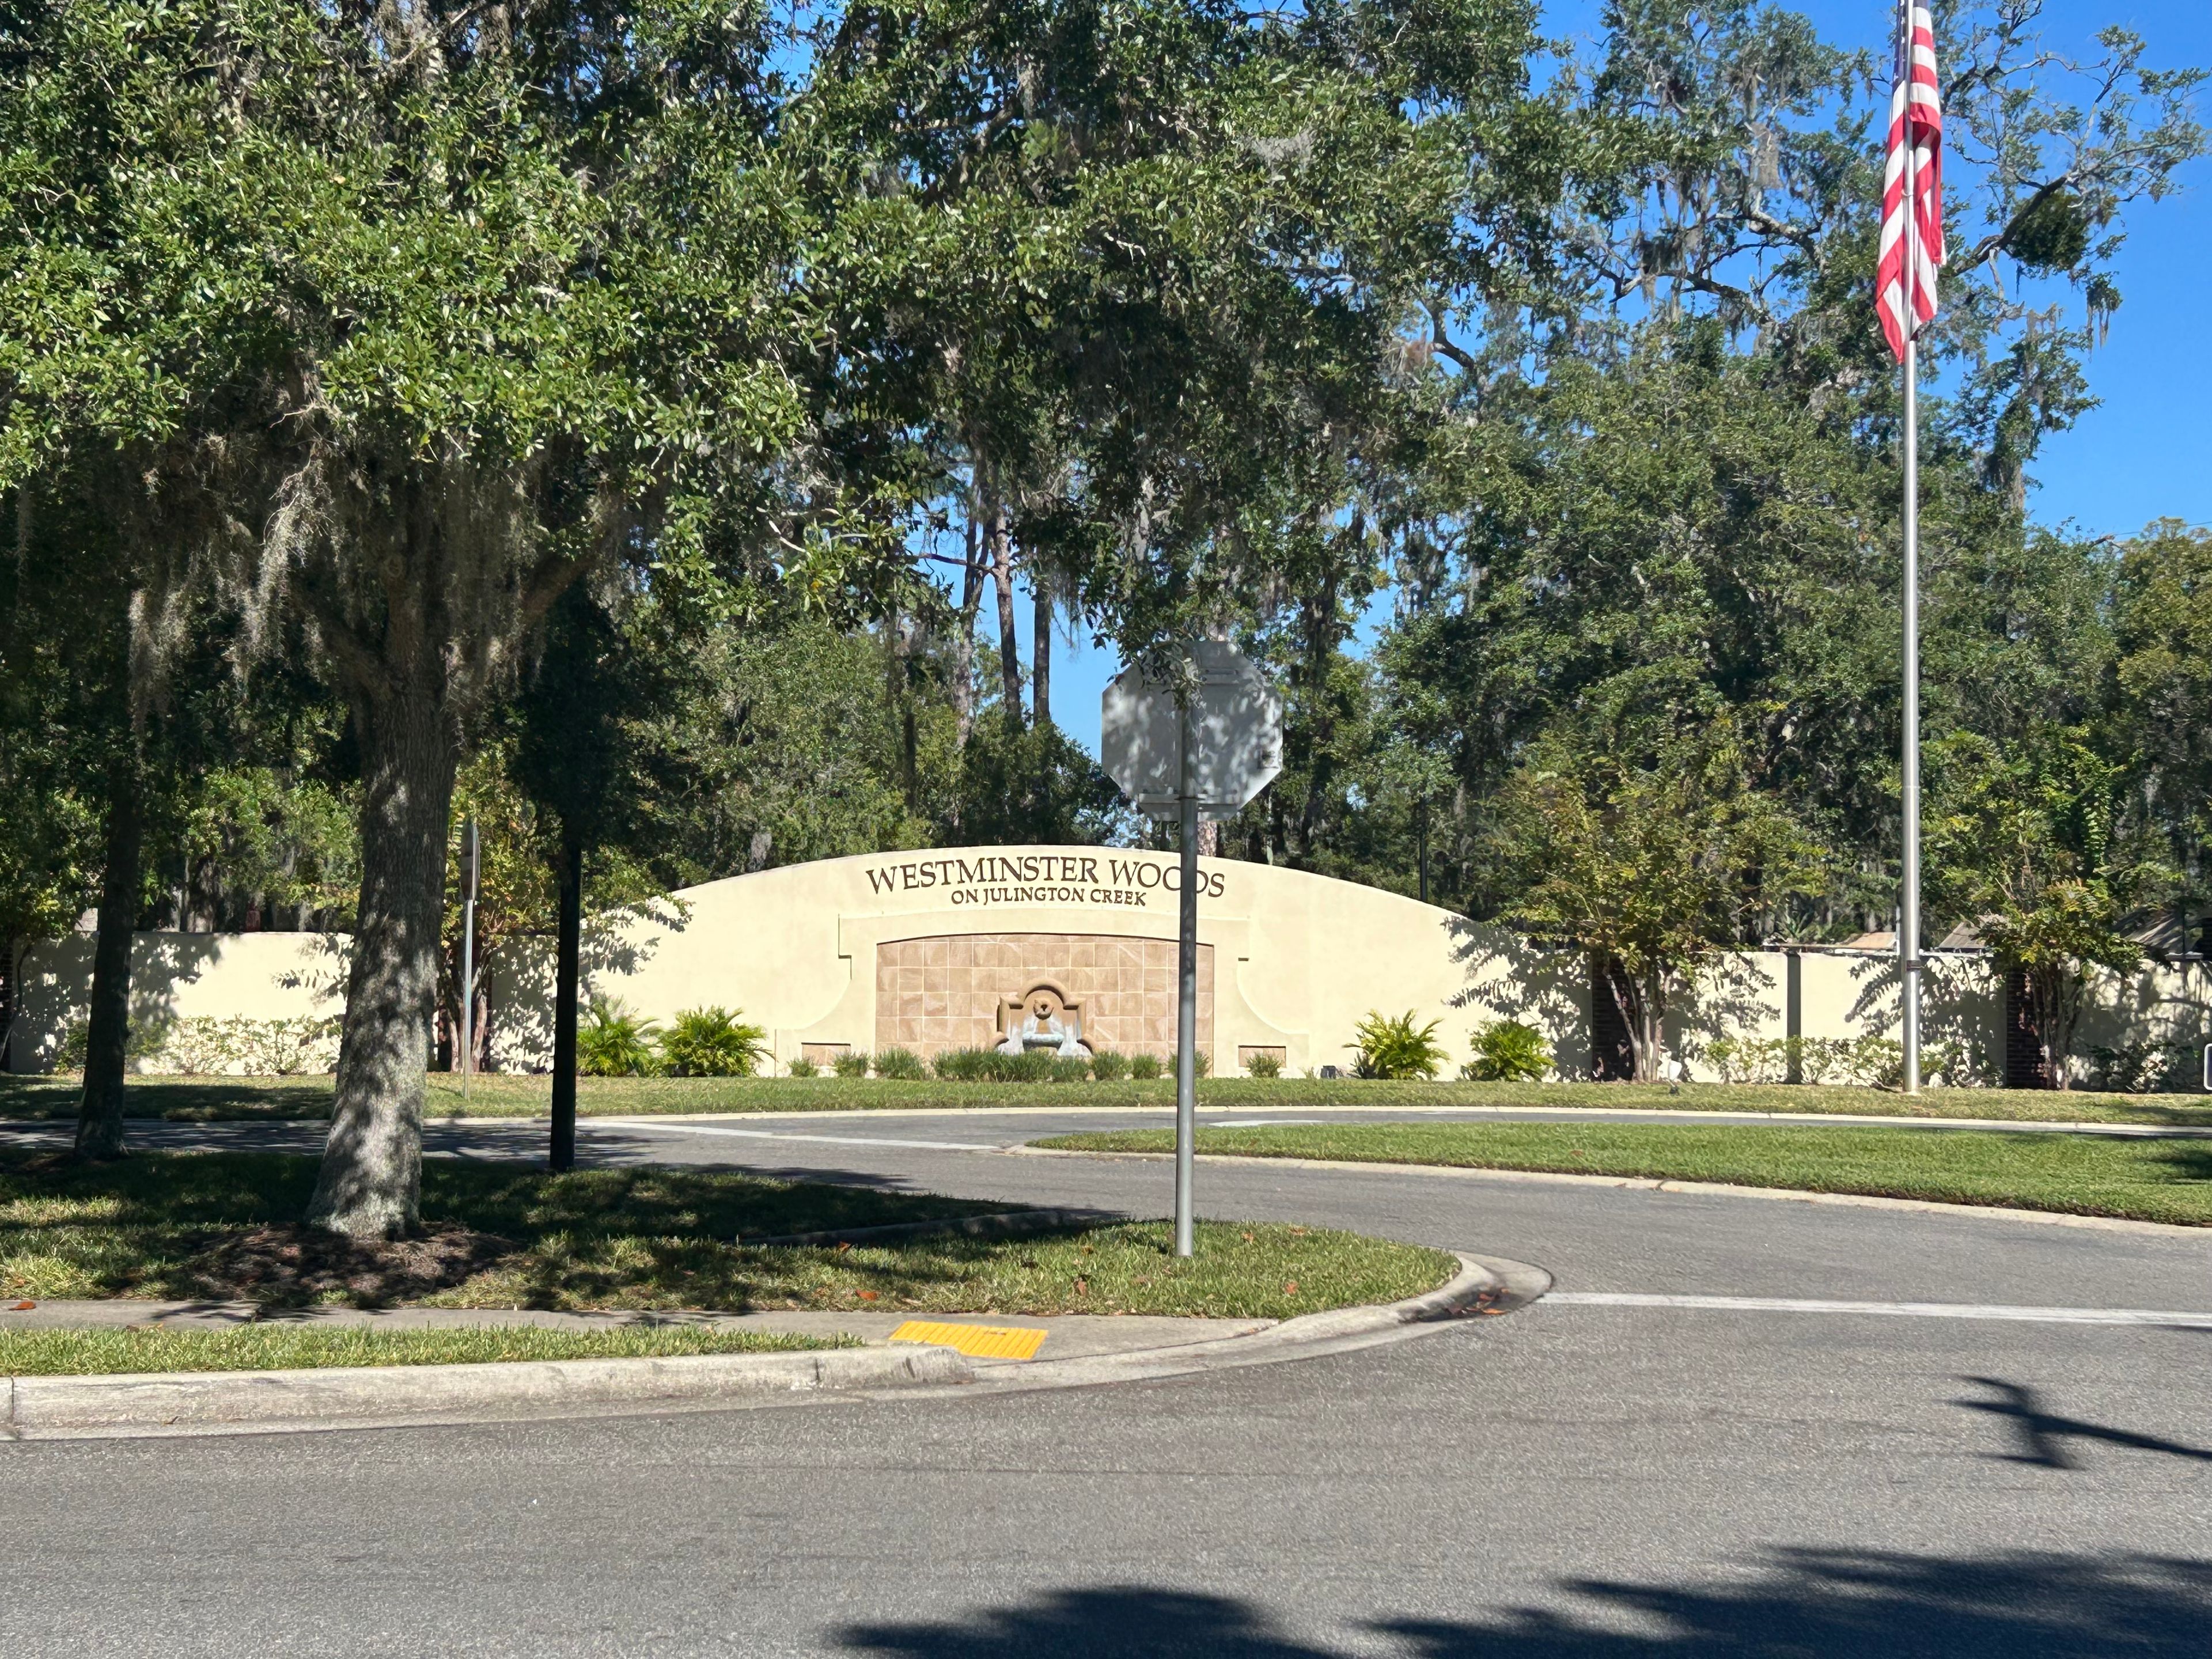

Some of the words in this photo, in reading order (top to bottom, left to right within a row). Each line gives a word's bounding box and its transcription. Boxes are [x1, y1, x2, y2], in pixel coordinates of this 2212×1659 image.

[865, 856, 1099, 895] WESTMINSTER
[951, 889, 979, 905] ON
[983, 887, 1085, 906] JULINGTON
[1090, 888, 1146, 907] CREEK
